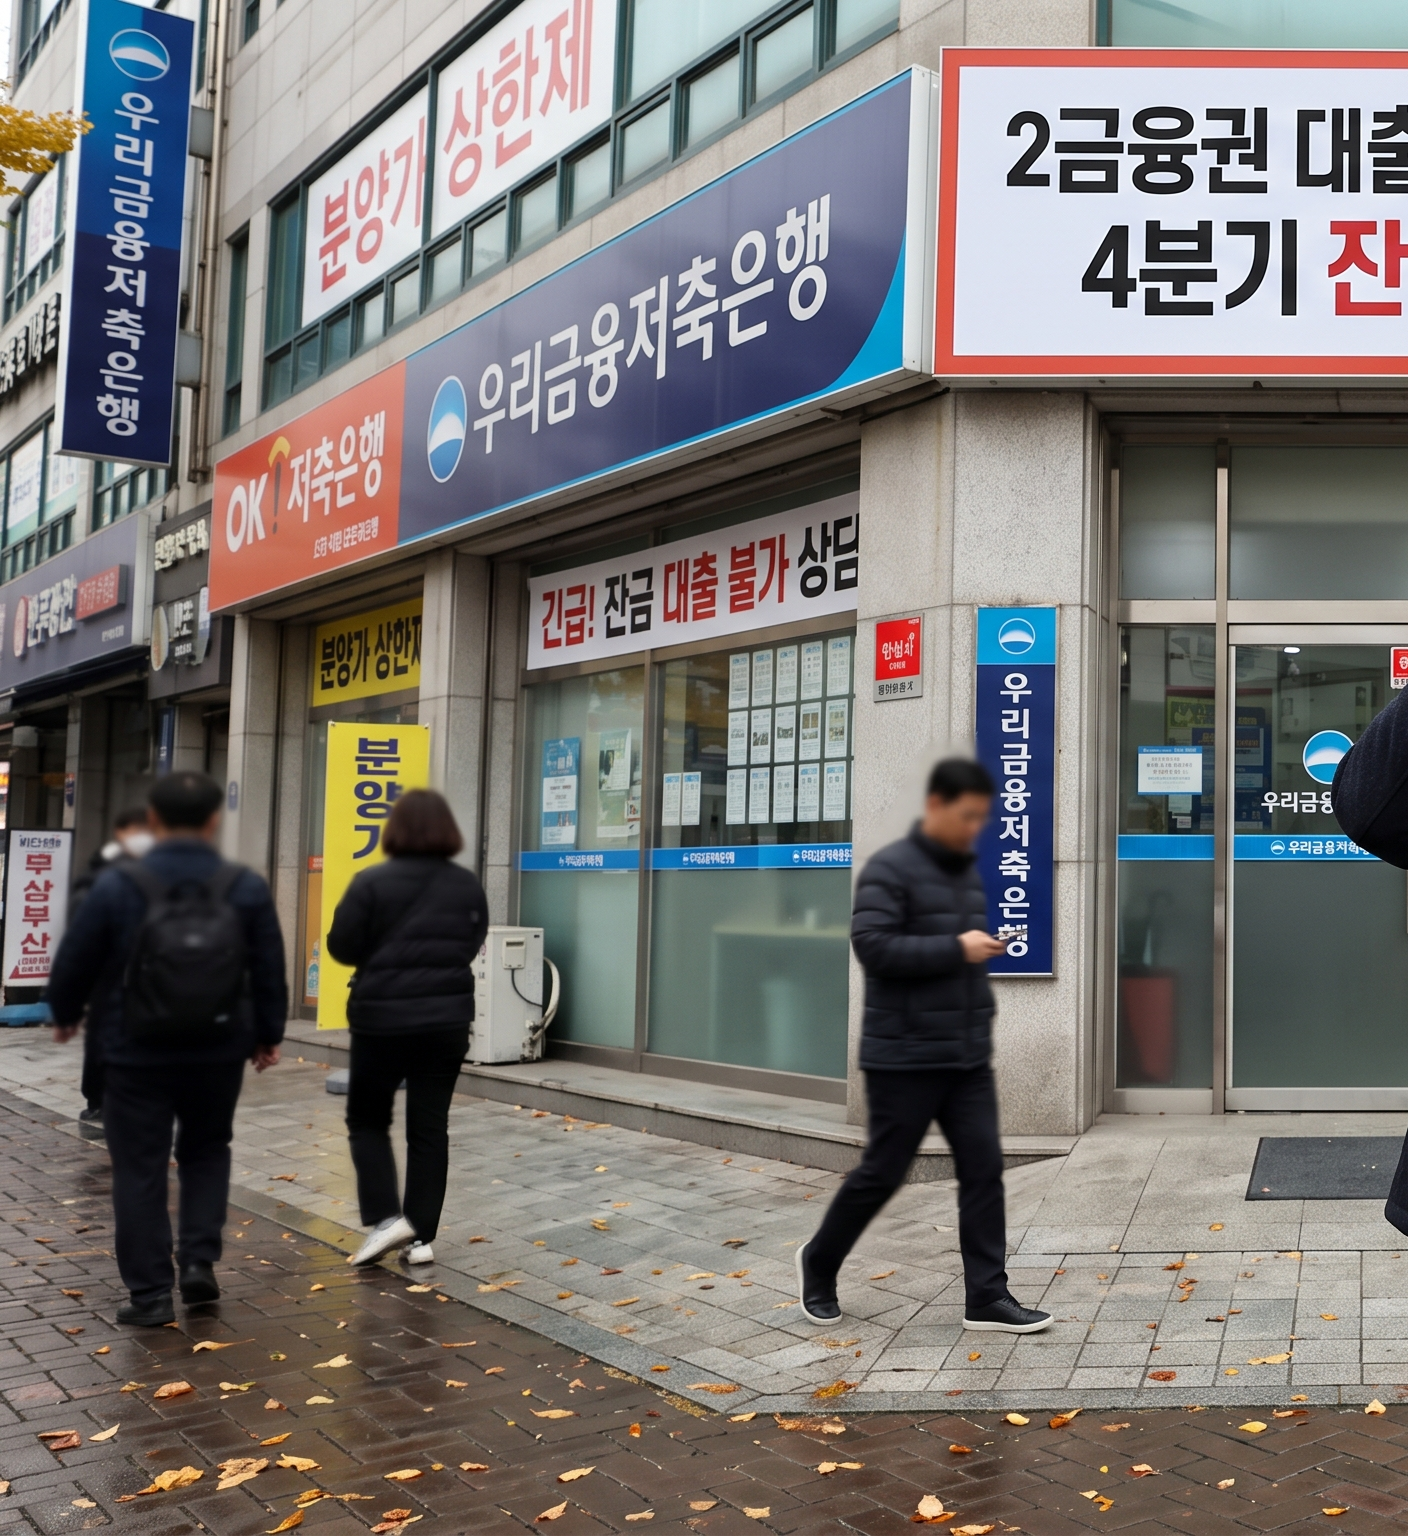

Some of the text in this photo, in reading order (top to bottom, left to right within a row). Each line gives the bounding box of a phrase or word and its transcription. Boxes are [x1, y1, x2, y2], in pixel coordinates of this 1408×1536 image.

[318, 0, 594, 293] 분양가 상한제
[1006, 105, 1269, 195] 2금융권
[97, 92, 160, 437] 우리금융저축은행
[1081, 219, 1298, 317] 4분기
[473, 193, 831, 455] 우리금융저축은행
[287, 410, 386, 523] 저축은행
[542, 583, 595, 650] 긴급!
[604, 567, 654, 639] 잔금
[663, 551, 718, 623] 대출
[728, 533, 789, 614] 불가
[321, 627, 370, 690] 분양가
[998, 672, 1032, 957] 우리금융저축은행
